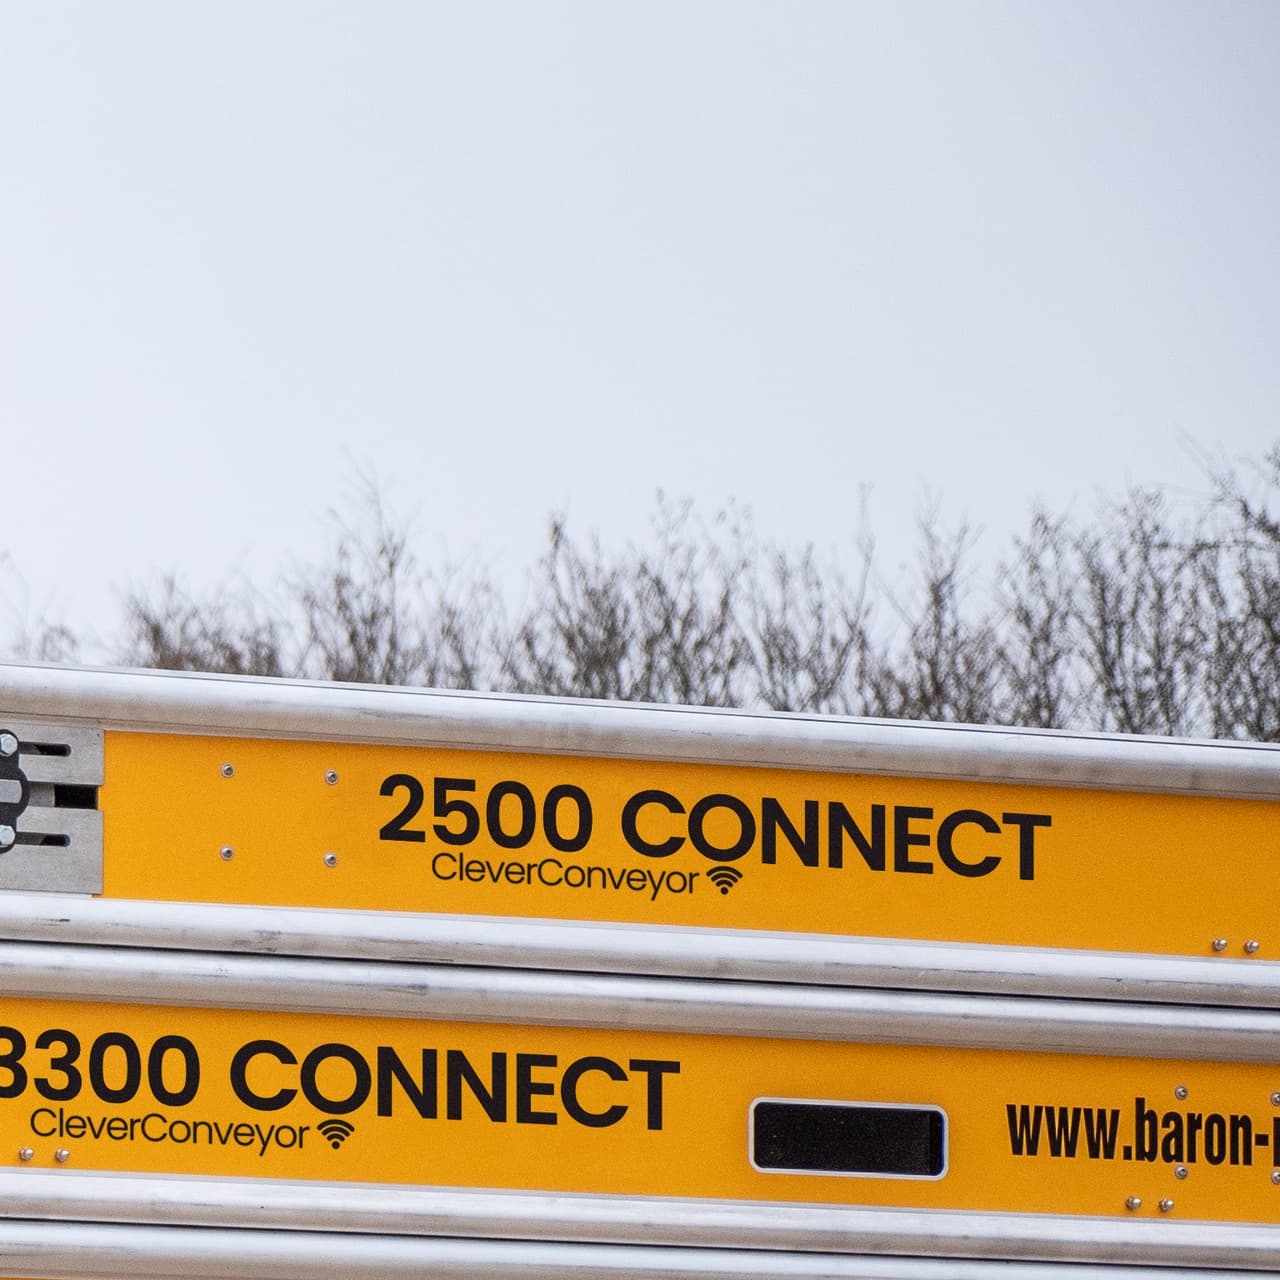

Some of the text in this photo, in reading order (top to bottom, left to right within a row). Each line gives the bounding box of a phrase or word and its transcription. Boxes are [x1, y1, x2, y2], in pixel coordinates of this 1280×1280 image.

[379, 773, 1052, 881] 2500 CONNECT
[431, 851, 700, 902] CleverConveyor
[229, 1039, 681, 1131] CONNECT
[30, 1106, 311, 1157] CleverConveyor
